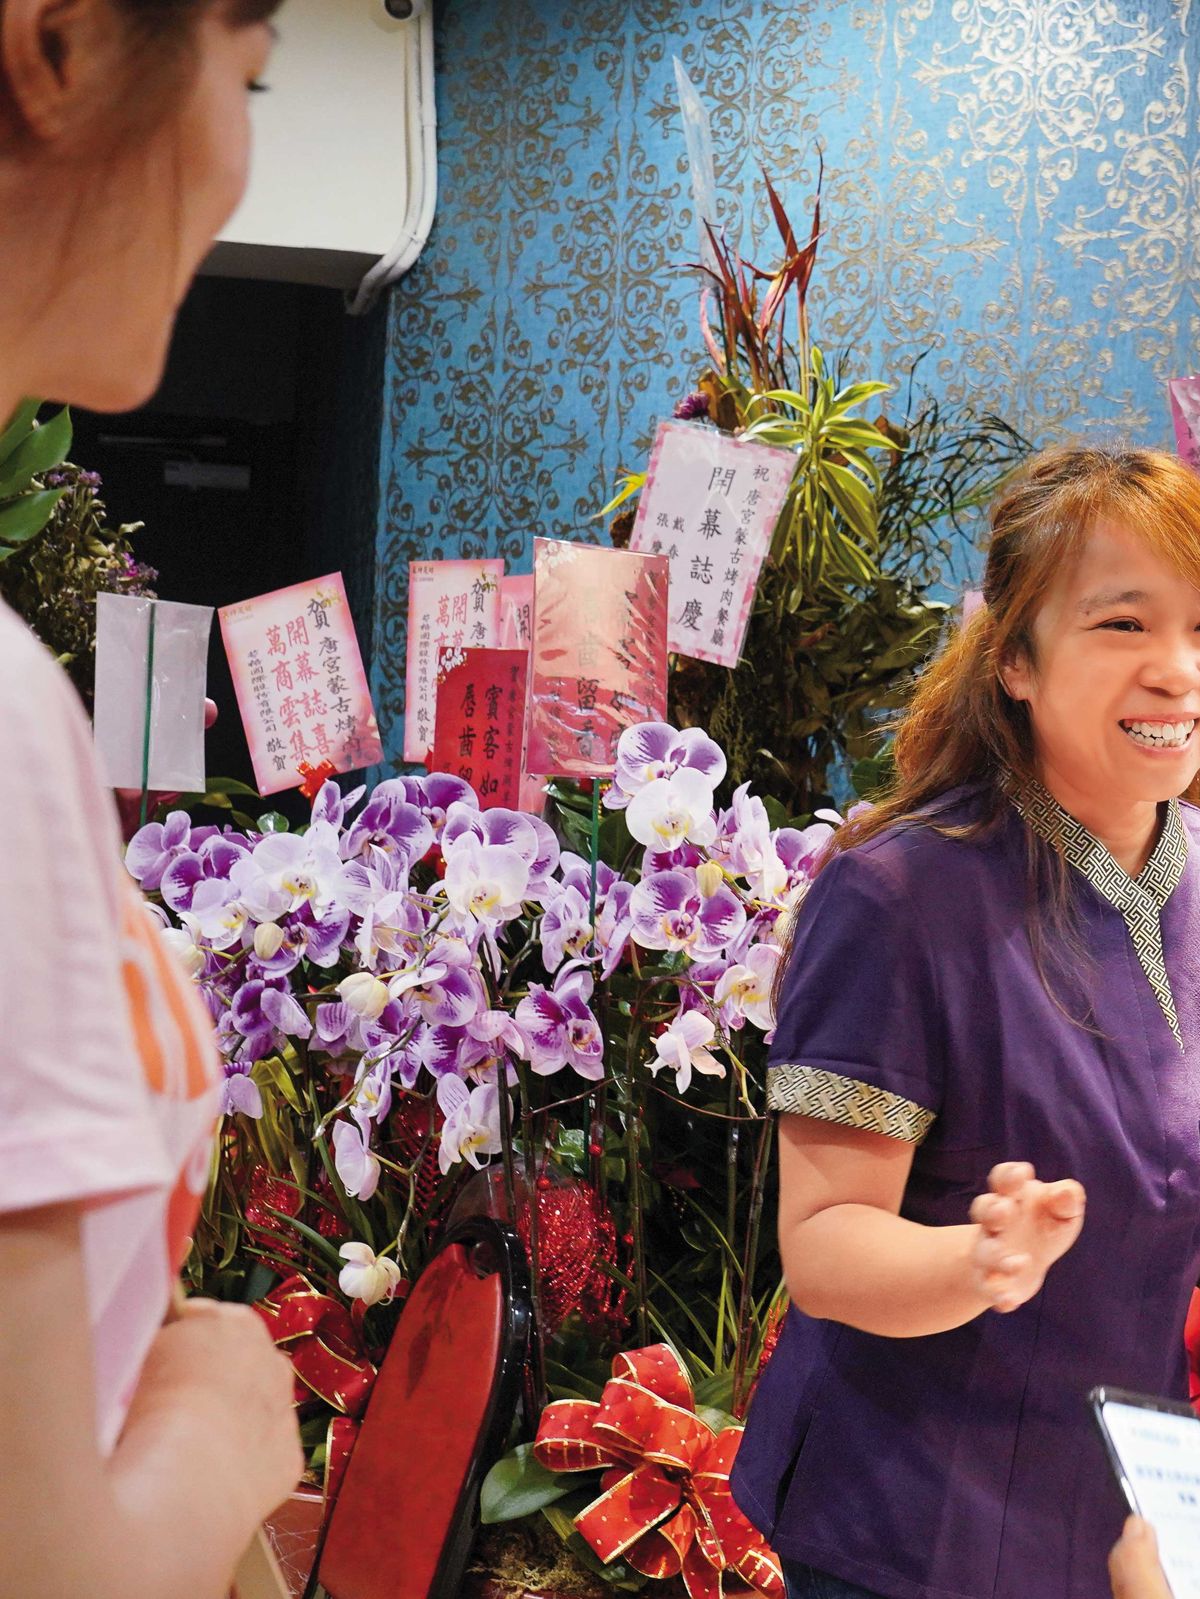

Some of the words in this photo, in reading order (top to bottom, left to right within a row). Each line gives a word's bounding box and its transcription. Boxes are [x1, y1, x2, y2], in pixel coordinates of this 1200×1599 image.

[676, 466, 737, 632] 開幕誌慶
[266, 624, 314, 762] 萬商雲集
[286, 615, 335, 755] 開幕誌喜
